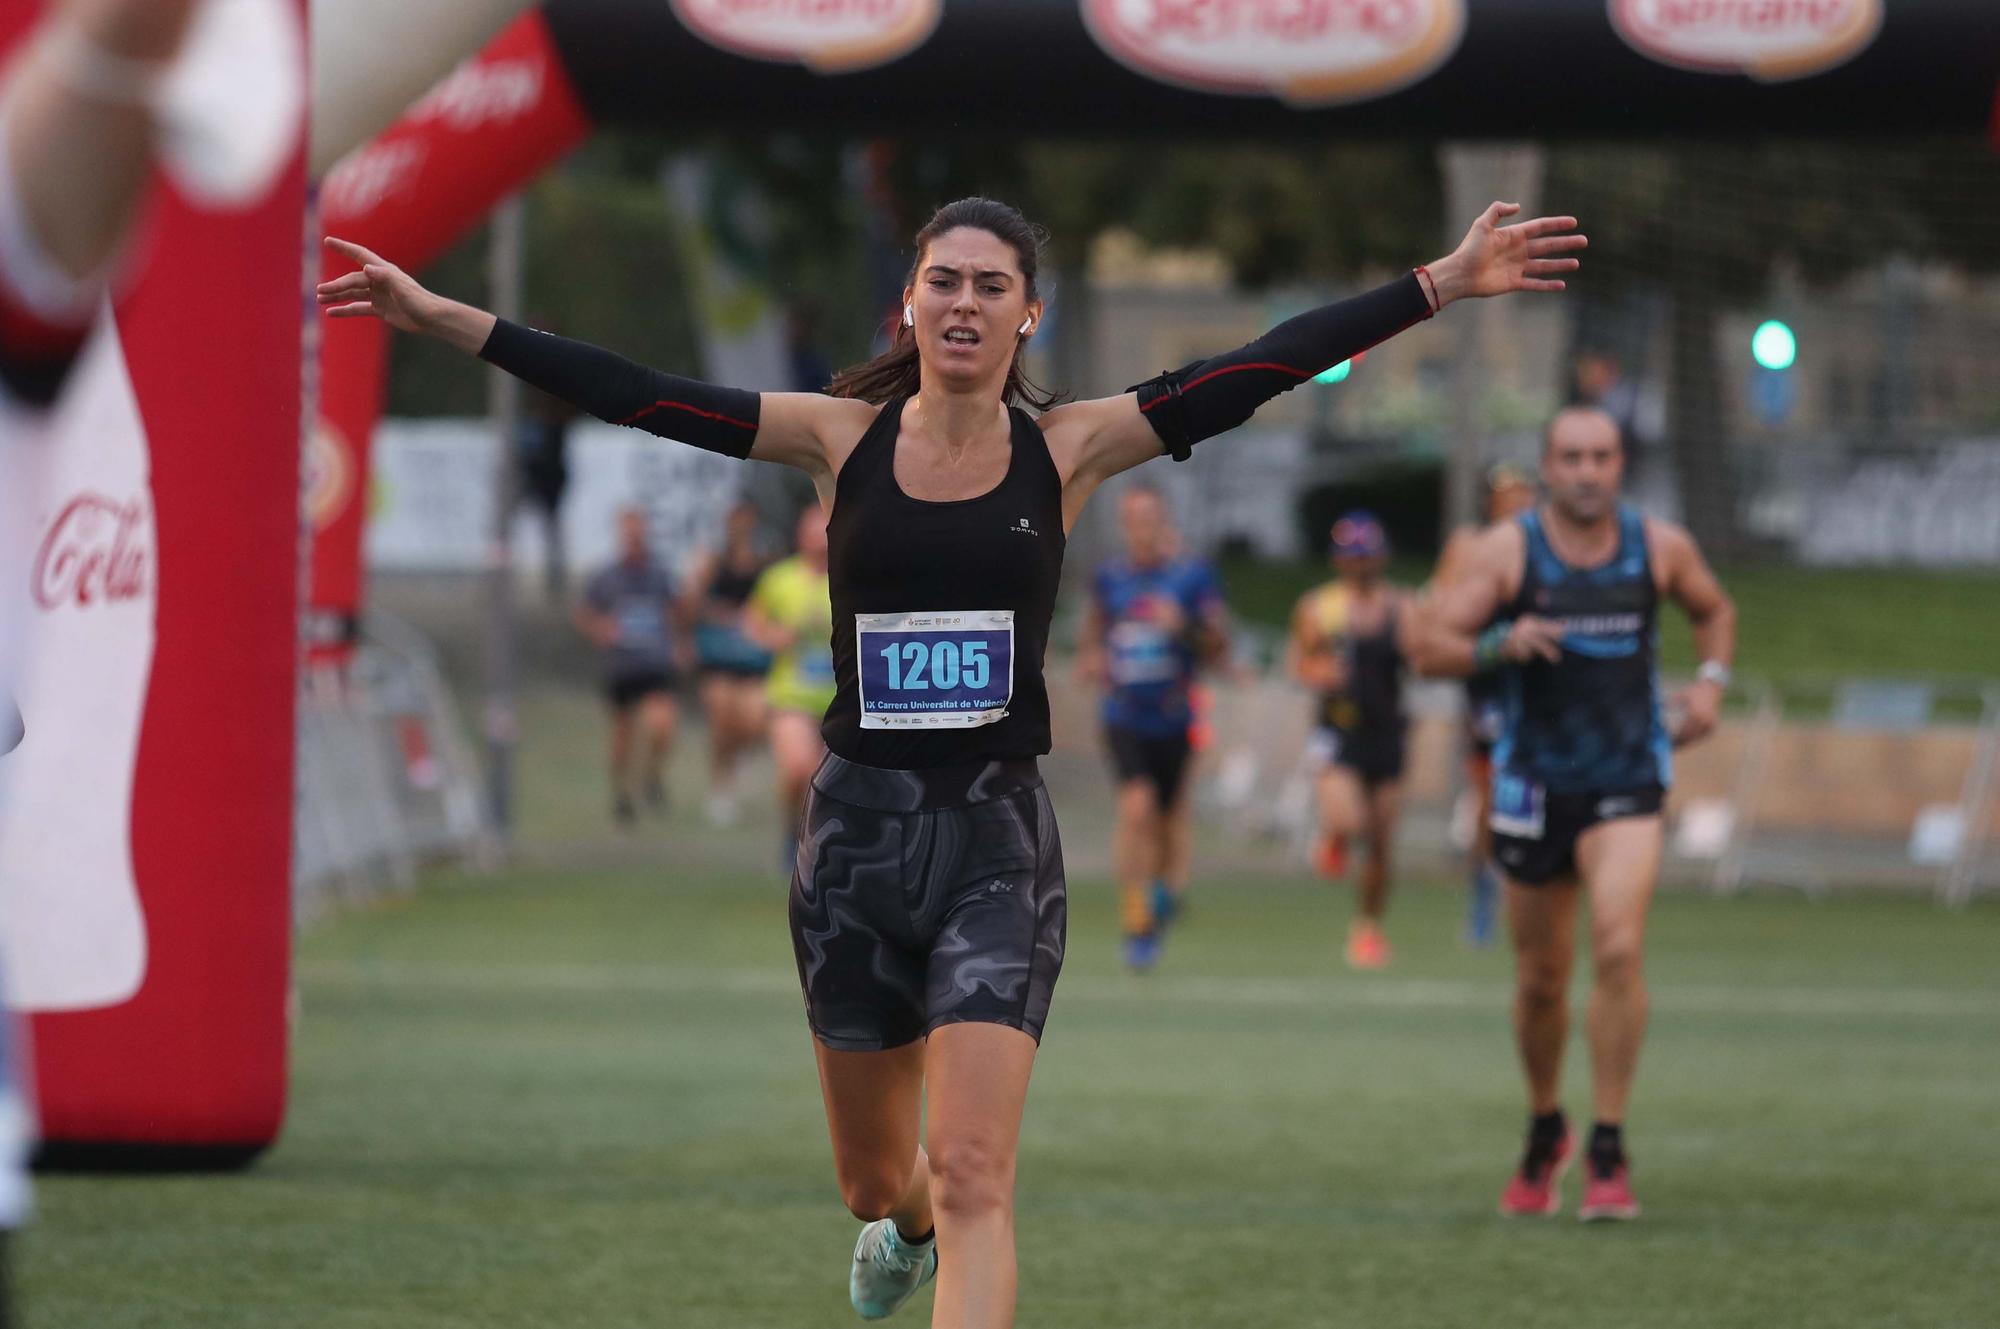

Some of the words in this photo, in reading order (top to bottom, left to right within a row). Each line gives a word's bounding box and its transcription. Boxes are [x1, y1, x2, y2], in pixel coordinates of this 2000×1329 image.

[880, 641, 990, 690] 1205
[866, 701, 876, 709] IX
[877, 701, 908, 709] Carrera
[910, 700, 958, 709] Universitat
[960, 700, 972, 708] de
